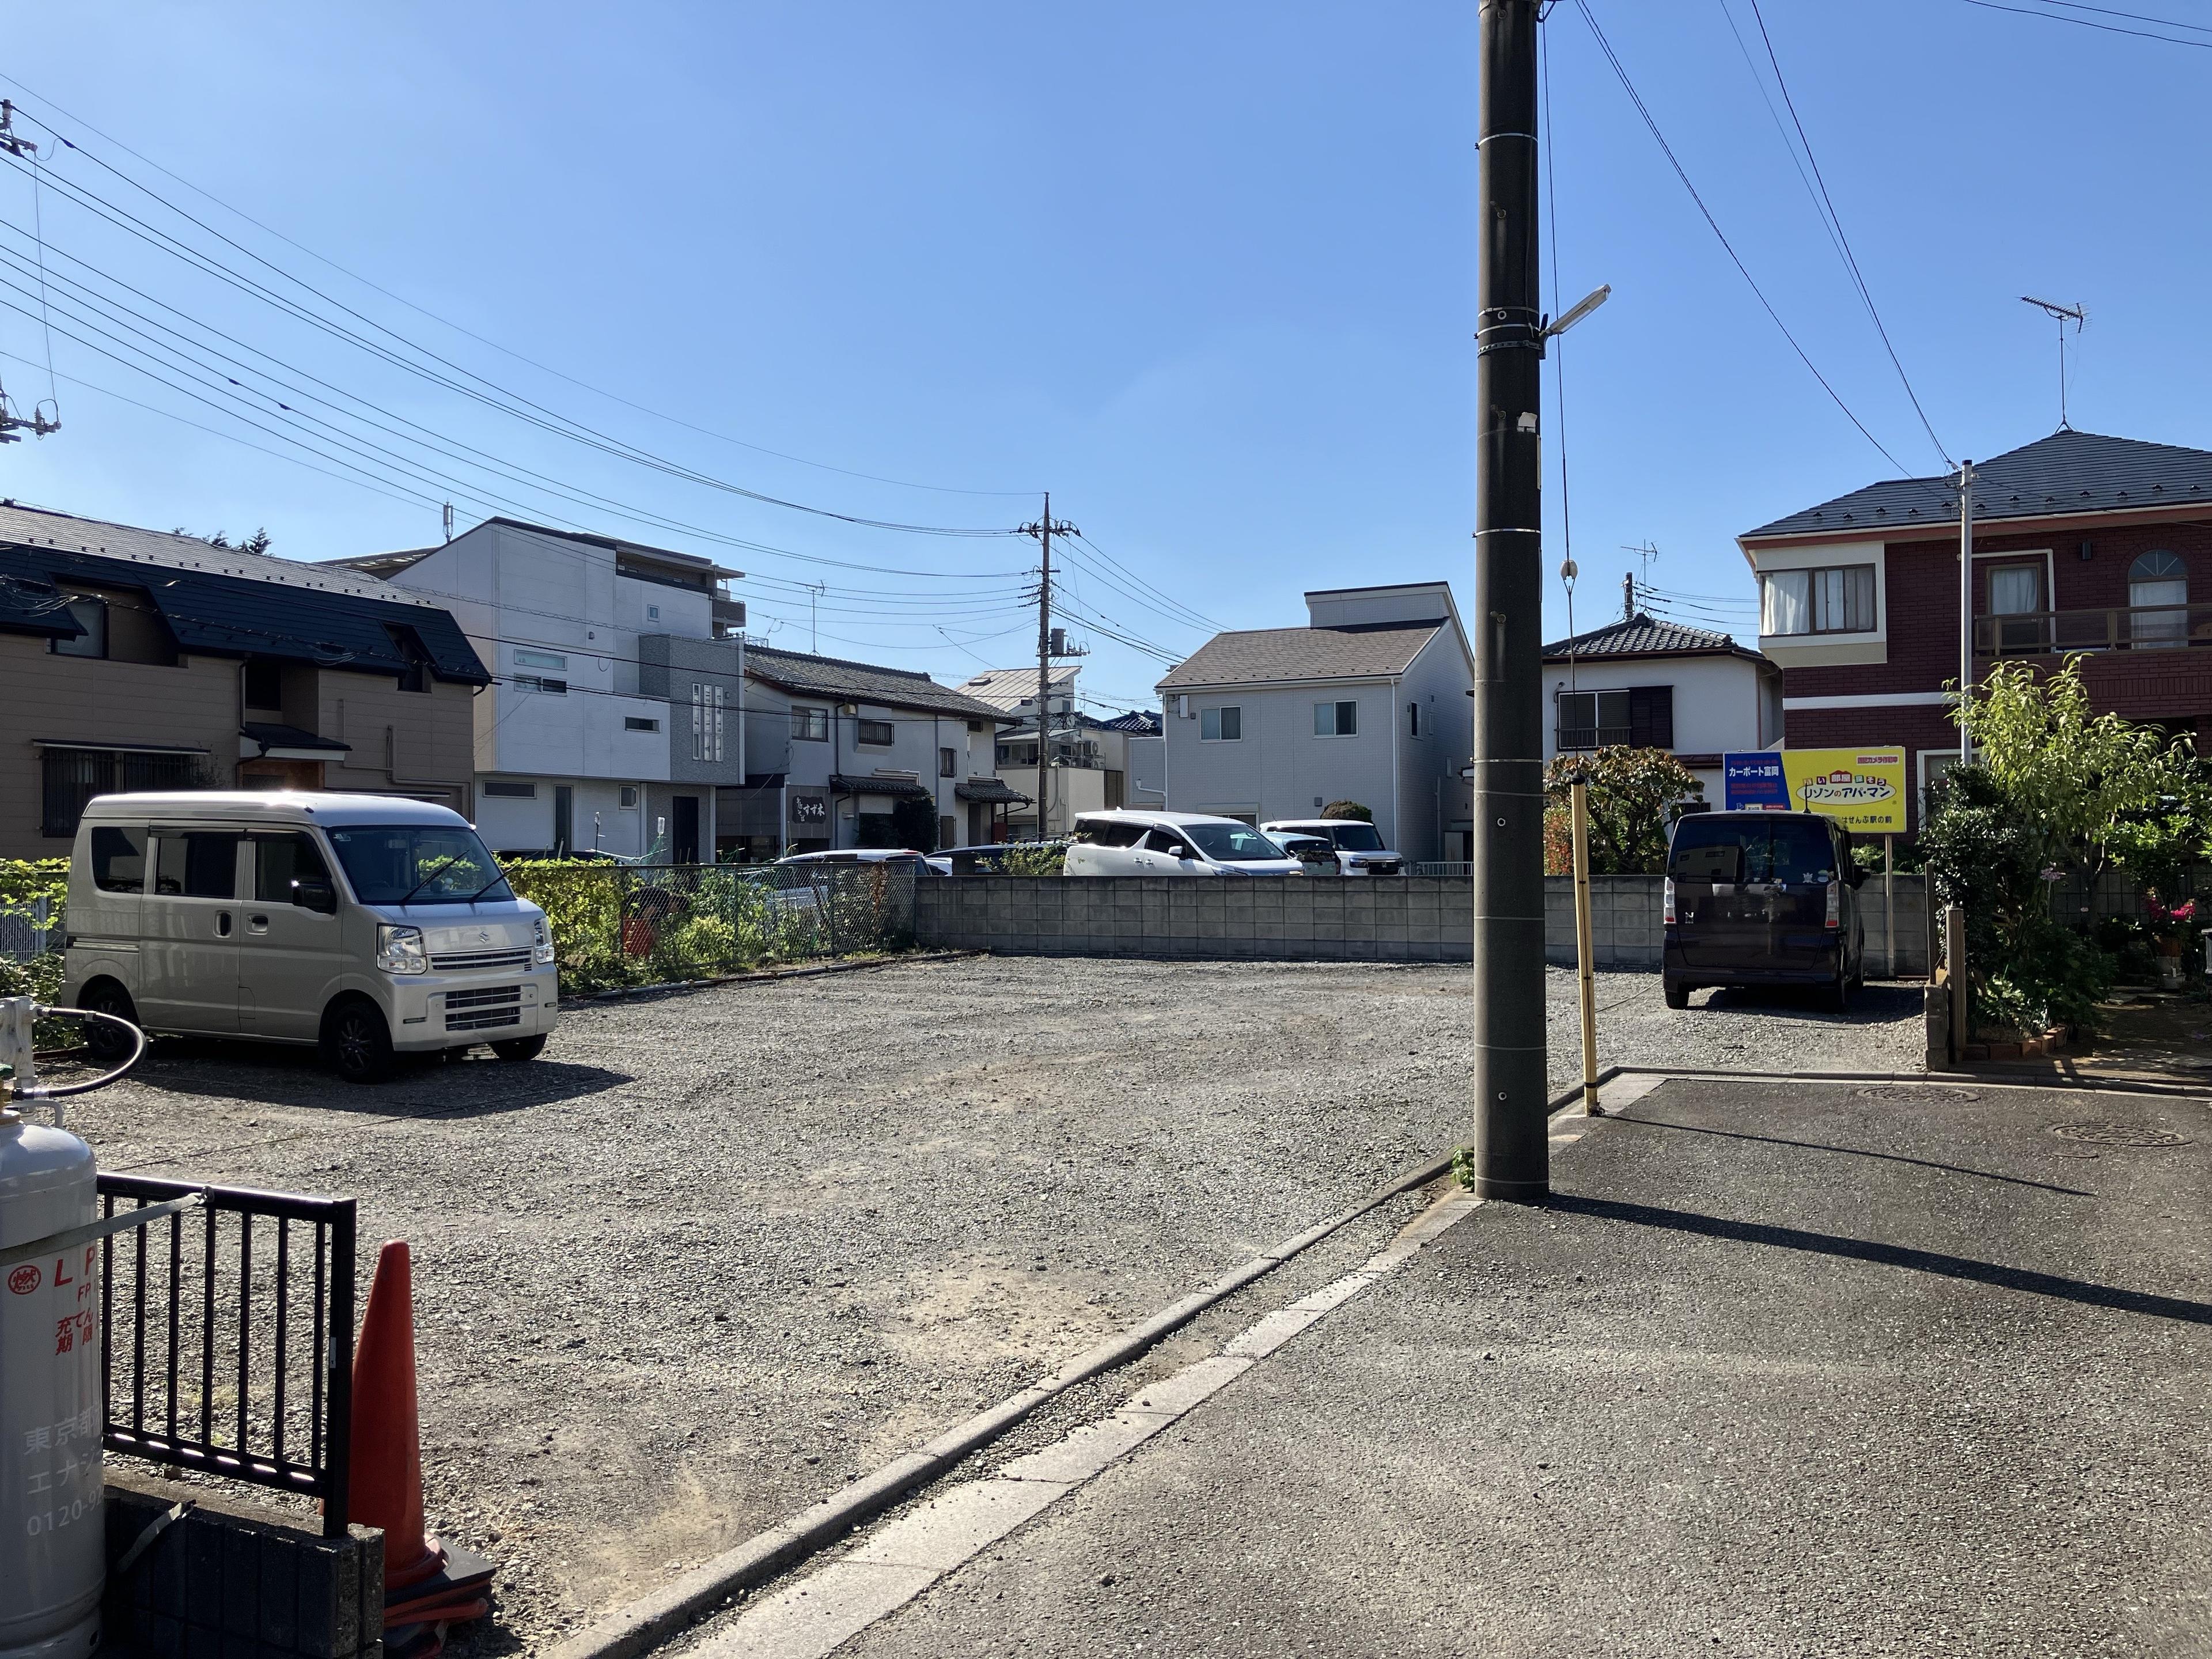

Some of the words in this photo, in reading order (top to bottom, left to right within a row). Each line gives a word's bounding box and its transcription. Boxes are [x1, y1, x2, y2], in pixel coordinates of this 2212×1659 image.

[1729, 766, 1779, 777] カーポート富岡
